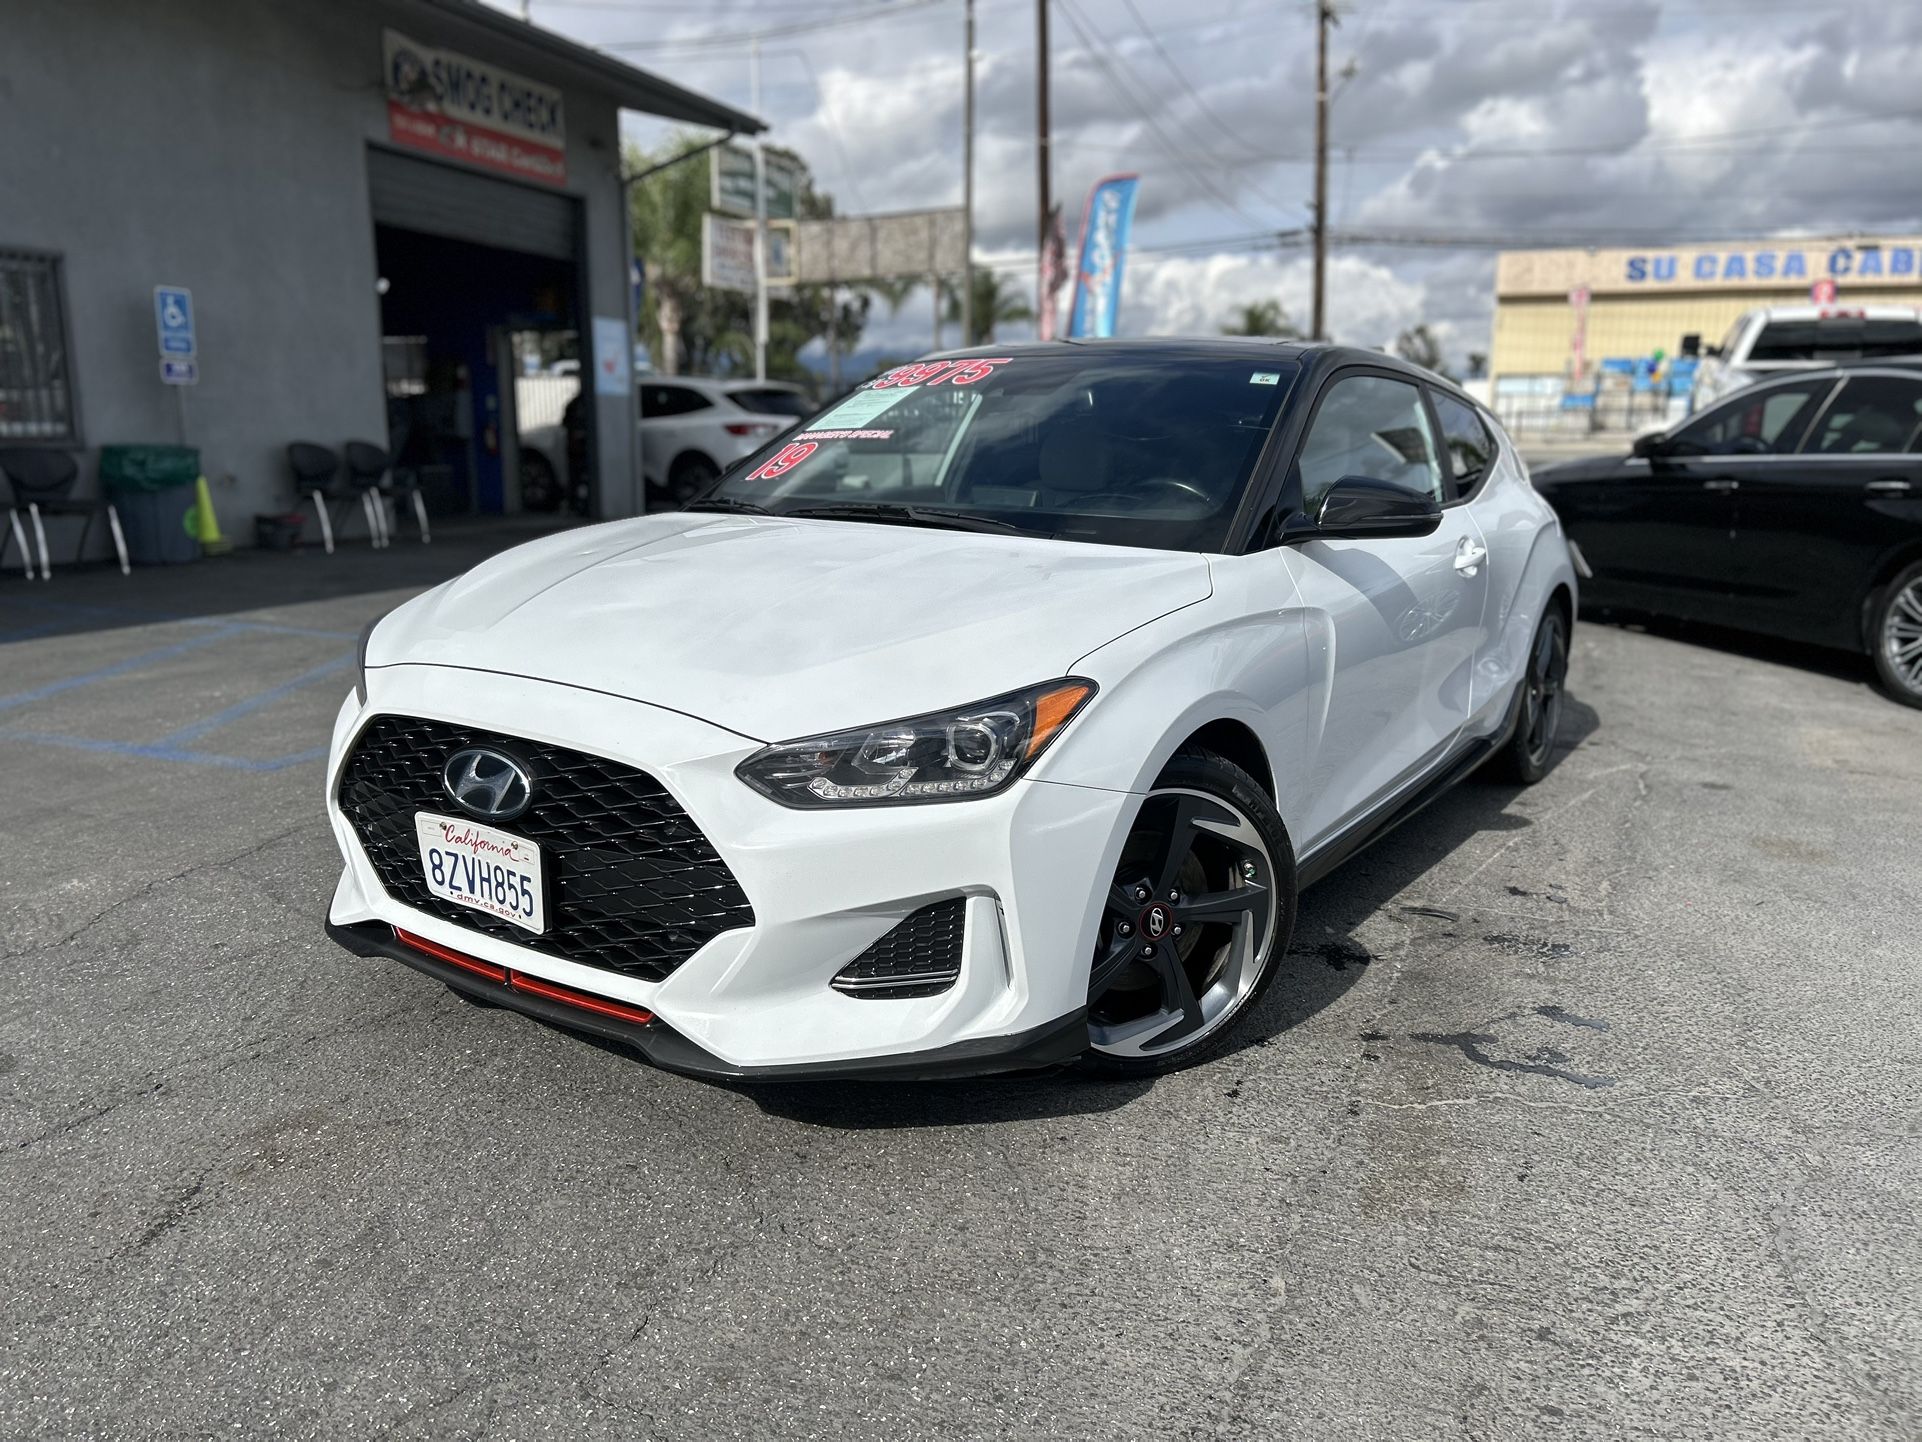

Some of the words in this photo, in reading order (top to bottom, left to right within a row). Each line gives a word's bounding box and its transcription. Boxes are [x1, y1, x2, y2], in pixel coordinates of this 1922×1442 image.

[432, 59, 492, 117] SMOG
[498, 80, 560, 138] CHECK
[1626, 256, 1676, 281] SU
[1694, 251, 1806, 280] CASA
[1829, 248, 1922, 276] CAB
[745, 441, 818, 480] 19
[445, 824, 519, 862] California
[429, 848, 533, 917] 8ZVH855
[456, 893, 517, 919] dmv.ca.gov
